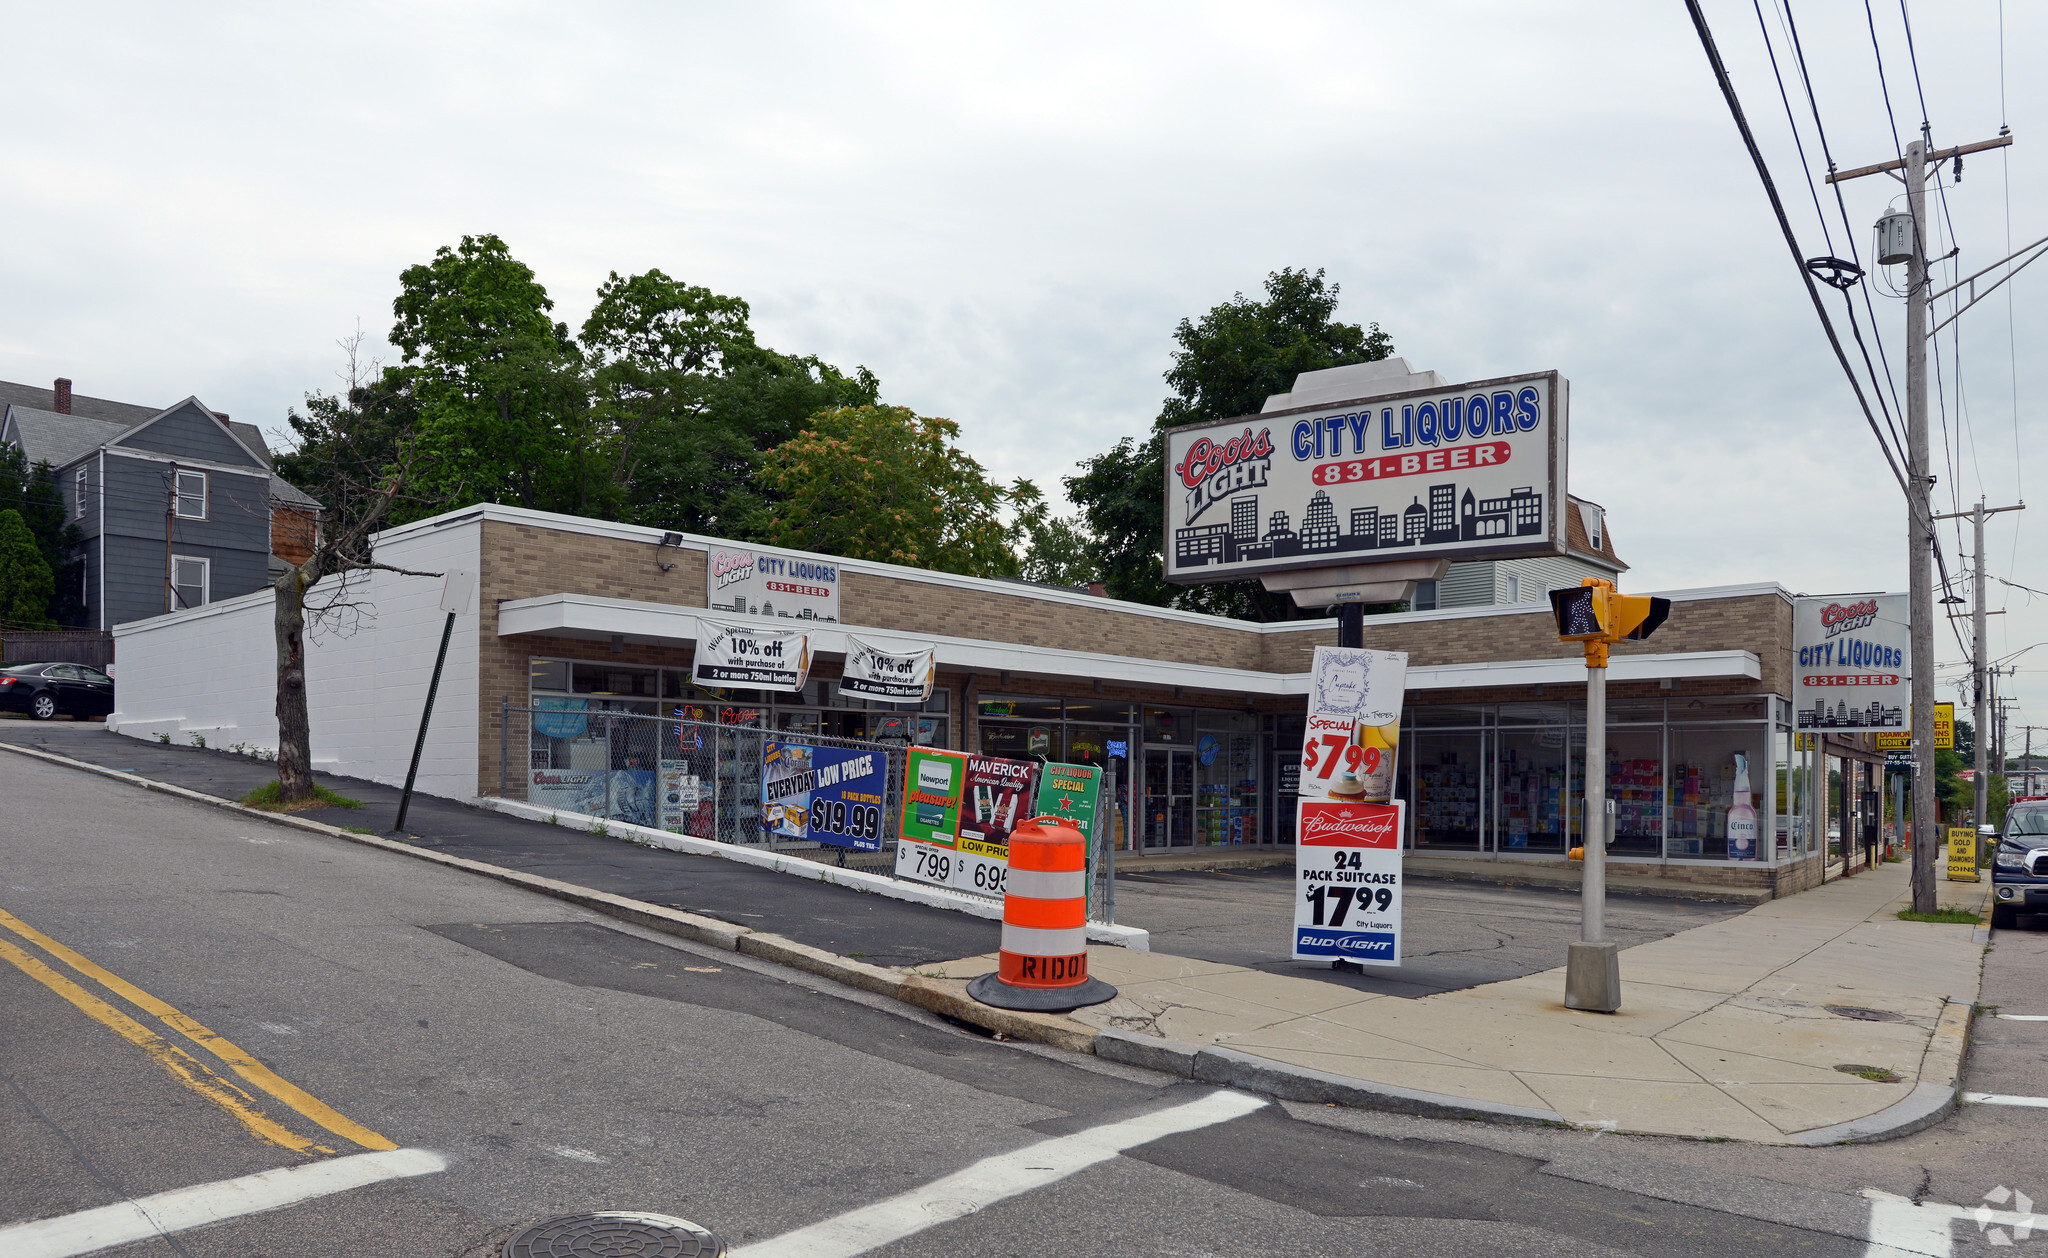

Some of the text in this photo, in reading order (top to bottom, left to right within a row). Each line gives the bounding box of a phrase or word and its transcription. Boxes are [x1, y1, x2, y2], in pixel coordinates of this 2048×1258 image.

[1292, 386, 1540, 461] CITY LIQUORS
[1176, 428, 1275, 488] Coors
[1324, 446, 1498, 483] 831-BEER
[1186, 458, 1270, 525] LIGHT
[712, 552, 754, 577] Coors
[758, 556, 836, 583] CITY LIQUORS
[718, 566, 753, 590] LIGHT
[770, 582, 825, 597] 831-BEER
[1820, 599, 1878, 627] Coors
[1825, 613, 1876, 639] LIGHT
[708, 633, 725, 652] Wine
[731, 638, 782, 657] 10% off
[1800, 637, 1902, 669] CITY LIQUORS
[727, 656, 784, 669] with purchase of
[871, 655, 914, 673] 10% off
[713, 669, 719, 678] 2
[730, 672, 749, 680] more
[750, 672, 772, 681] 750ml
[773, 673, 796, 684] bottles
[868, 672, 880, 680] with
[882, 675, 908, 683] purchase
[1329, 674, 1357, 692] Cupcake
[1808, 676, 1893, 685] 831-BEER
[853, 680, 859, 689] 2
[868, 685, 885, 693] more
[886, 686, 904, 695] 750ml
[905, 687, 923, 696] bottles
[1358, 710, 1394, 721] ALL TYPES
[1309, 715, 1356, 735] SPECIAL!
[766, 742, 776, 753] CITY
[764, 750, 781, 764] LIQUORS
[784, 757, 809, 768] Corona
[533, 771, 591, 785] Coors LIGHT
[817, 754, 874, 789] LOW PRICE
[969, 759, 1029, 779] MAVERICK
[1050, 765, 1093, 779] CITY LIQUOR
[767, 770, 815, 800] EVERYDAY
[920, 773, 949, 786] Newport
[970, 774, 1024, 792] American Quality
[1052, 779, 1085, 792] SPECIAL
[841, 791, 881, 804] 18 PACK BOTTLES
[908, 788, 957, 809] pleasure!
[811, 797, 879, 840] $19.99
[919, 817, 940, 826] CIGARETTES
[1303, 816, 1393, 834] Budweiser
[1731, 821, 1754, 830] Cinco
[1951, 830, 1974, 838] BUYING
[853, 840, 876, 850] PLUS TAX
[962, 840, 1009, 858] LOW PRIC
[900, 847, 950, 880] $ 7.99
[958, 860, 964, 872] $
[1334, 851, 1362, 870] 24
[1303, 870, 1396, 884] PACK SUITCASE
[1356, 920, 1392, 929] City Liquors
[1299, 936, 1392, 950] BUD LIGHT
